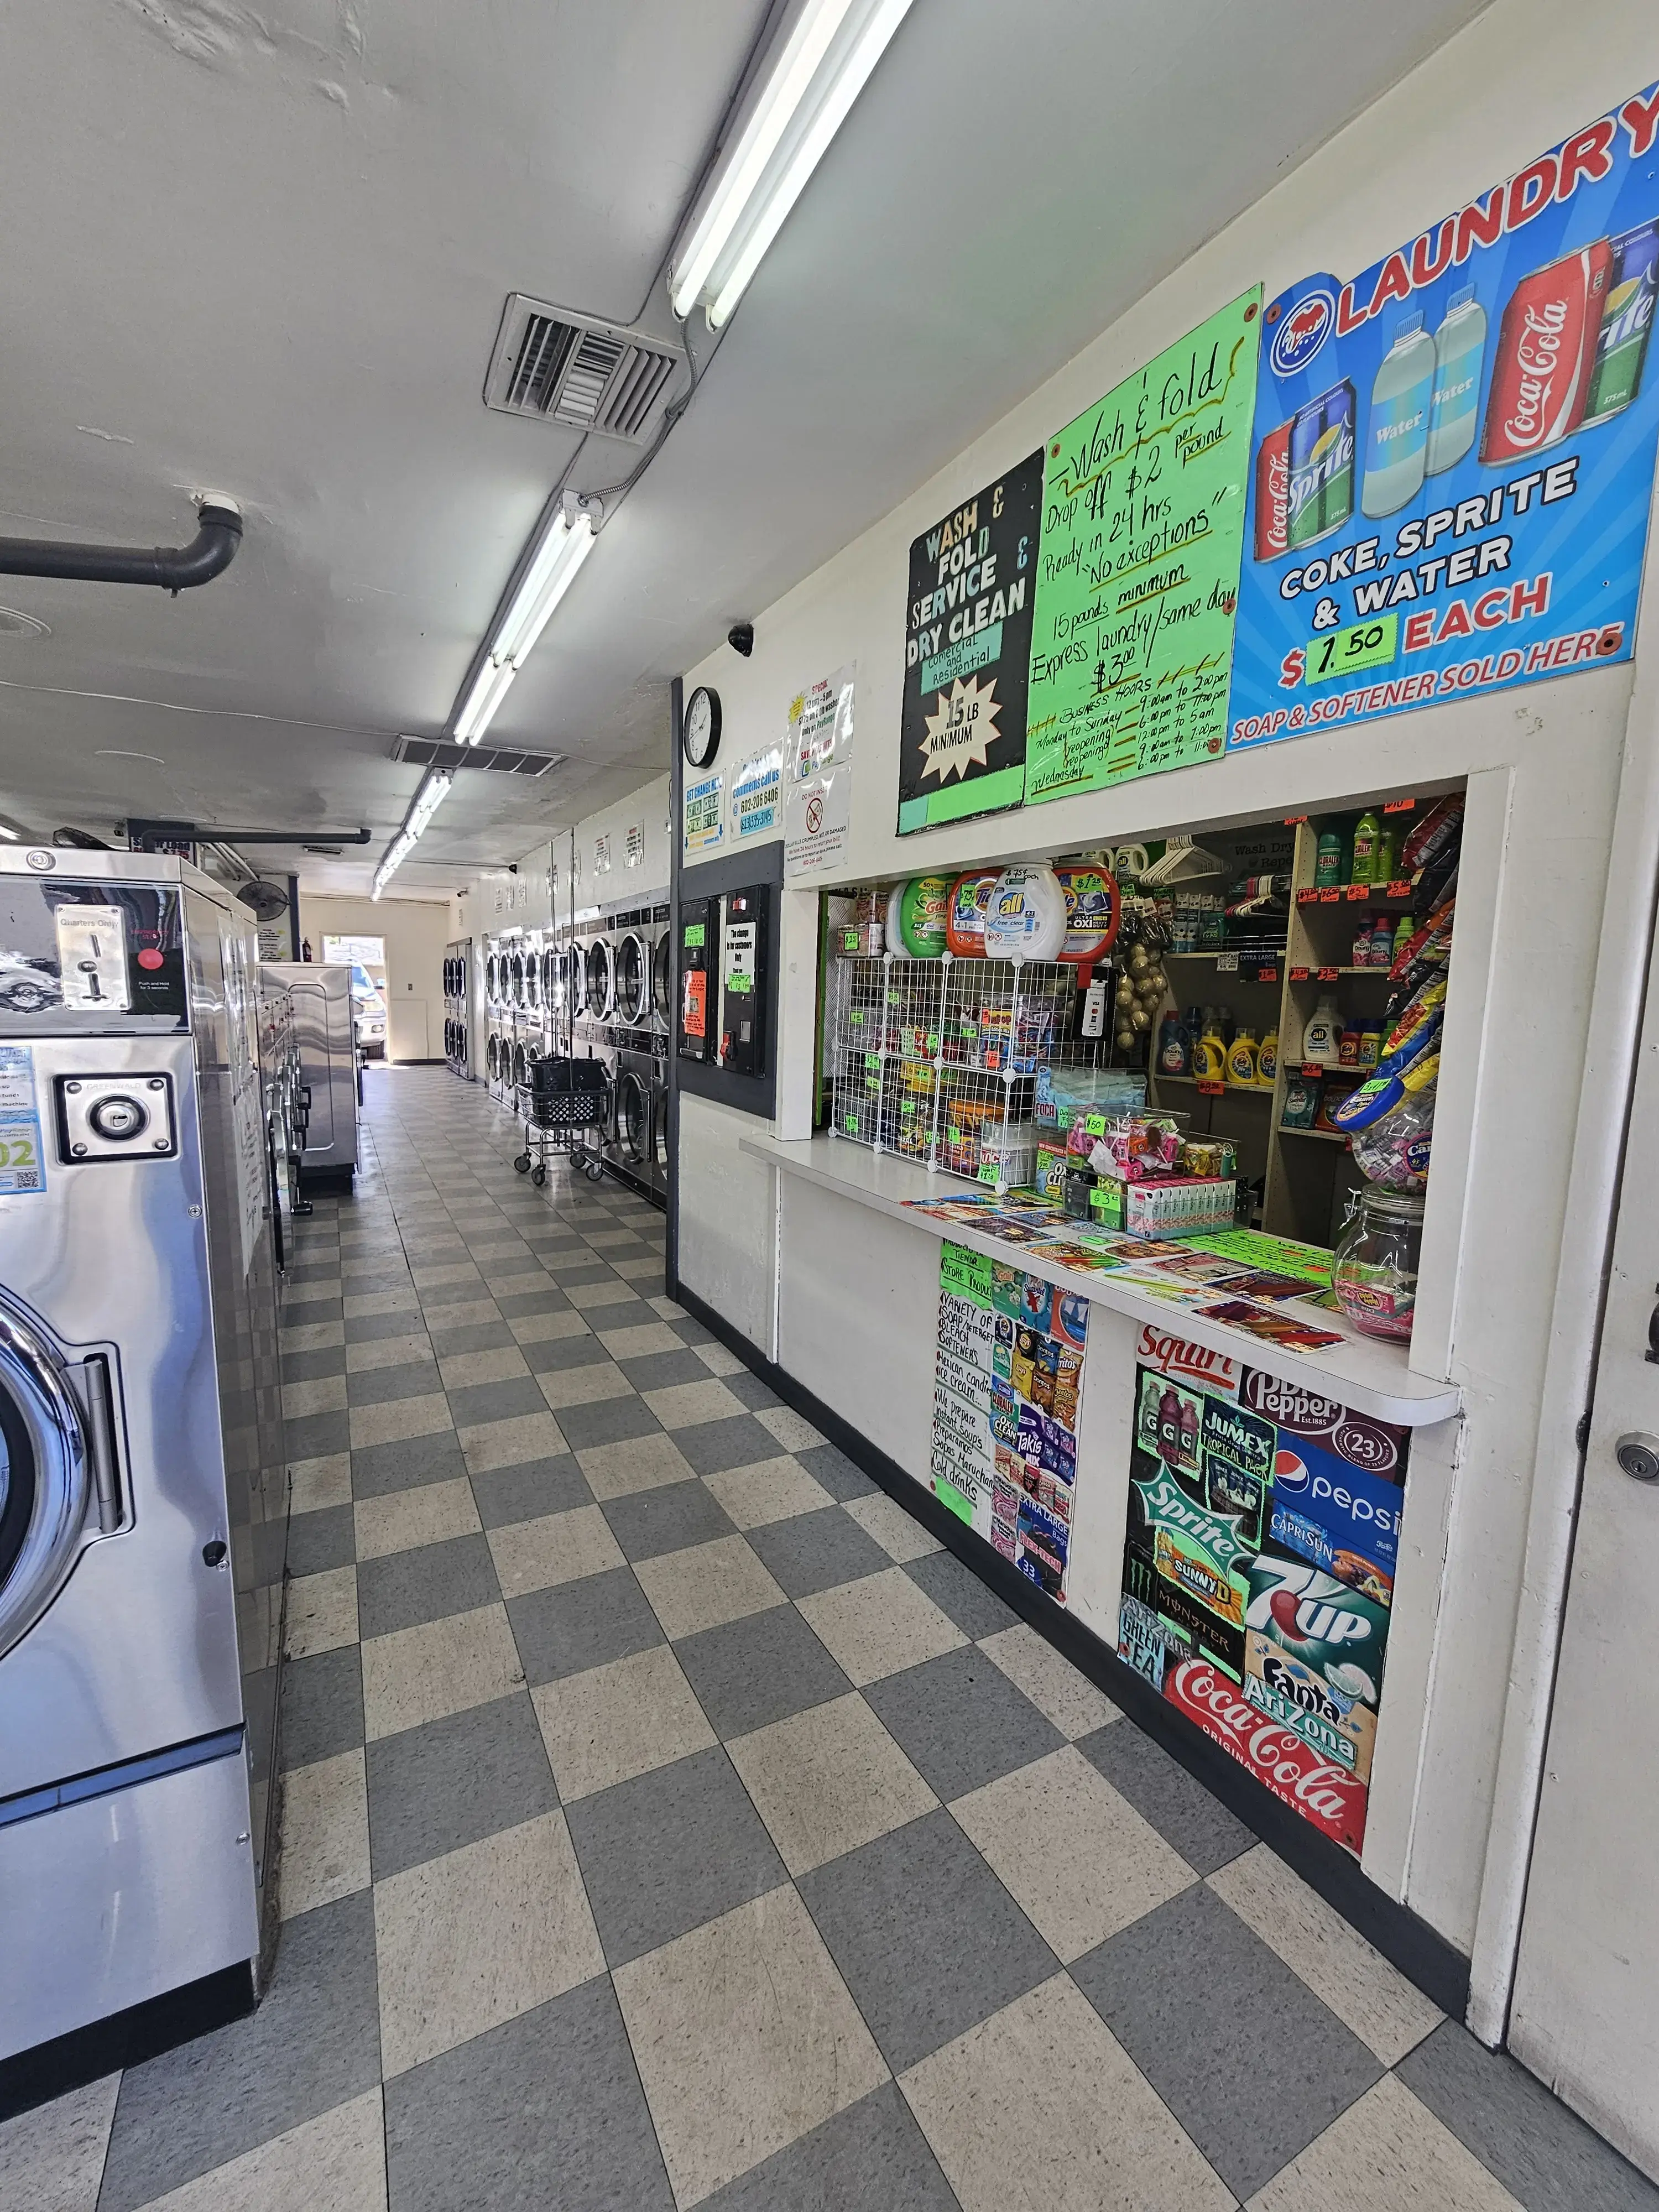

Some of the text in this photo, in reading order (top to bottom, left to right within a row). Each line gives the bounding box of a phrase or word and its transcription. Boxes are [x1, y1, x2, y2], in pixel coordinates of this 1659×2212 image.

[1335, 86, 1659, 336] LAUNDRY
[1071, 410, 1124, 479] Wash
[1175, 422, 1197, 458] per
[1183, 416, 1224, 469] pound
[1376, 413, 1423, 445] Water
[1288, 436, 1353, 515] Sprite
[1084, 471, 1112, 520] off
[926, 500, 978, 562] WASH
[1045, 498, 1077, 534] Drop
[1281, 456, 1579, 599] COKE, SPRITE
[937, 526, 989, 586] FOLD
[1043, 495, 1171, 582] Ready in 24 hrs
[912, 554, 997, 629] SERVICE
[1313, 535, 1512, 631] & WATER
[1053, 616, 1070, 640] 15
[1118, 564, 1190, 606] minimum
[1402, 571, 1553, 654] EACH
[907, 577, 1025, 667] DRY CLEAN
[933, 646, 989, 685] Residential
[947, 652, 961, 668] and
[1031, 640, 1088, 685] Express
[701, 693, 706, 705] 12
[946, 696, 979, 729] 15 LB
[1060, 694, 1109, 723] BUSINESS
[1176, 700, 1186, 713] to
[1231, 711, 1286, 743] SOAP
[1288, 705, 1306, 728] &
[1307, 672, 1434, 722] SOFTENER
[1438, 651, 1522, 694] SOLD
[1036, 730, 1068, 751] Monday
[1070, 722, 1081, 736] to
[1085, 710, 1123, 732] Sunday
[1177, 680, 1188, 698] to
[1173, 714, 1185, 728] to
[1190, 708, 1198, 723] 5
[930, 725, 973, 754] MINIMUM
[1175, 745, 1183, 758] to
[1031, 731, 1183, 792] Wednesday to
[695, 781, 711, 799] CHANGE
[733, 769, 779, 799] comments call us
[741, 787, 778, 813] 602-206 6406
[808, 790, 816, 799] NOT
[830, 826, 846, 834] DAMAGED
[1235, 844, 1265, 855] Wash
[999, 892, 1025, 915] all
[1073, 920, 1093, 928] OXI
[1312, 1030, 1324, 1039] all
[1036, 1103, 1055, 1117] FOCA
[941, 1257, 964, 1280] STORE
[953, 1249, 978, 1266] TIENDA
[998, 1270, 1014, 1282] Gain
[1024, 1283, 1045, 1296] Suavitel
[941, 1291, 992, 1329] VARIETY OF
[940, 1318, 969, 1345] BLEACH
[1037, 1344, 1055, 1358] Doritos
[937, 1351, 992, 1397] Mexican candies
[1033, 1375, 1050, 1390] Doritos
[937, 1387, 975, 1427] We prepare
[1256, 1374, 1338, 1421] Pepper
[936, 1406, 957, 1426] instant
[994, 1419, 1016, 1439] CLEAN
[1000, 1415, 1013, 1429] OXI
[1206, 1412, 1271, 1455] JUMEX
[935, 1418, 972, 1455] Preparamos
[1017, 1432, 1042, 1453] Takis
[1202, 1432, 1241, 1465] TROPICAL
[1351, 1434, 1375, 1458] 23
[932, 1450, 978, 1501] Cold drinks
[933, 1432, 995, 1489] Sopas Maruchan
[1019, 1495, 1068, 1535] EXTRA LARGE
[1146, 1481, 1237, 1558] Sprite
[1312, 1477, 1401, 1536] pepsi
[1052, 1530, 1067, 1547] Bags
[1023, 1559, 1035, 1578] 33
[1123, 1615, 1161, 1657] GREEN
[1159, 1590, 1230, 1652] MONSTER
[1262, 1657, 1342, 1728] Fanta
[1244, 1675, 1357, 1762] AriZona
[1175, 1659, 1360, 1819] Coca-Cola
[1202, 1724, 1307, 1819] ORIGINAL TASTE
